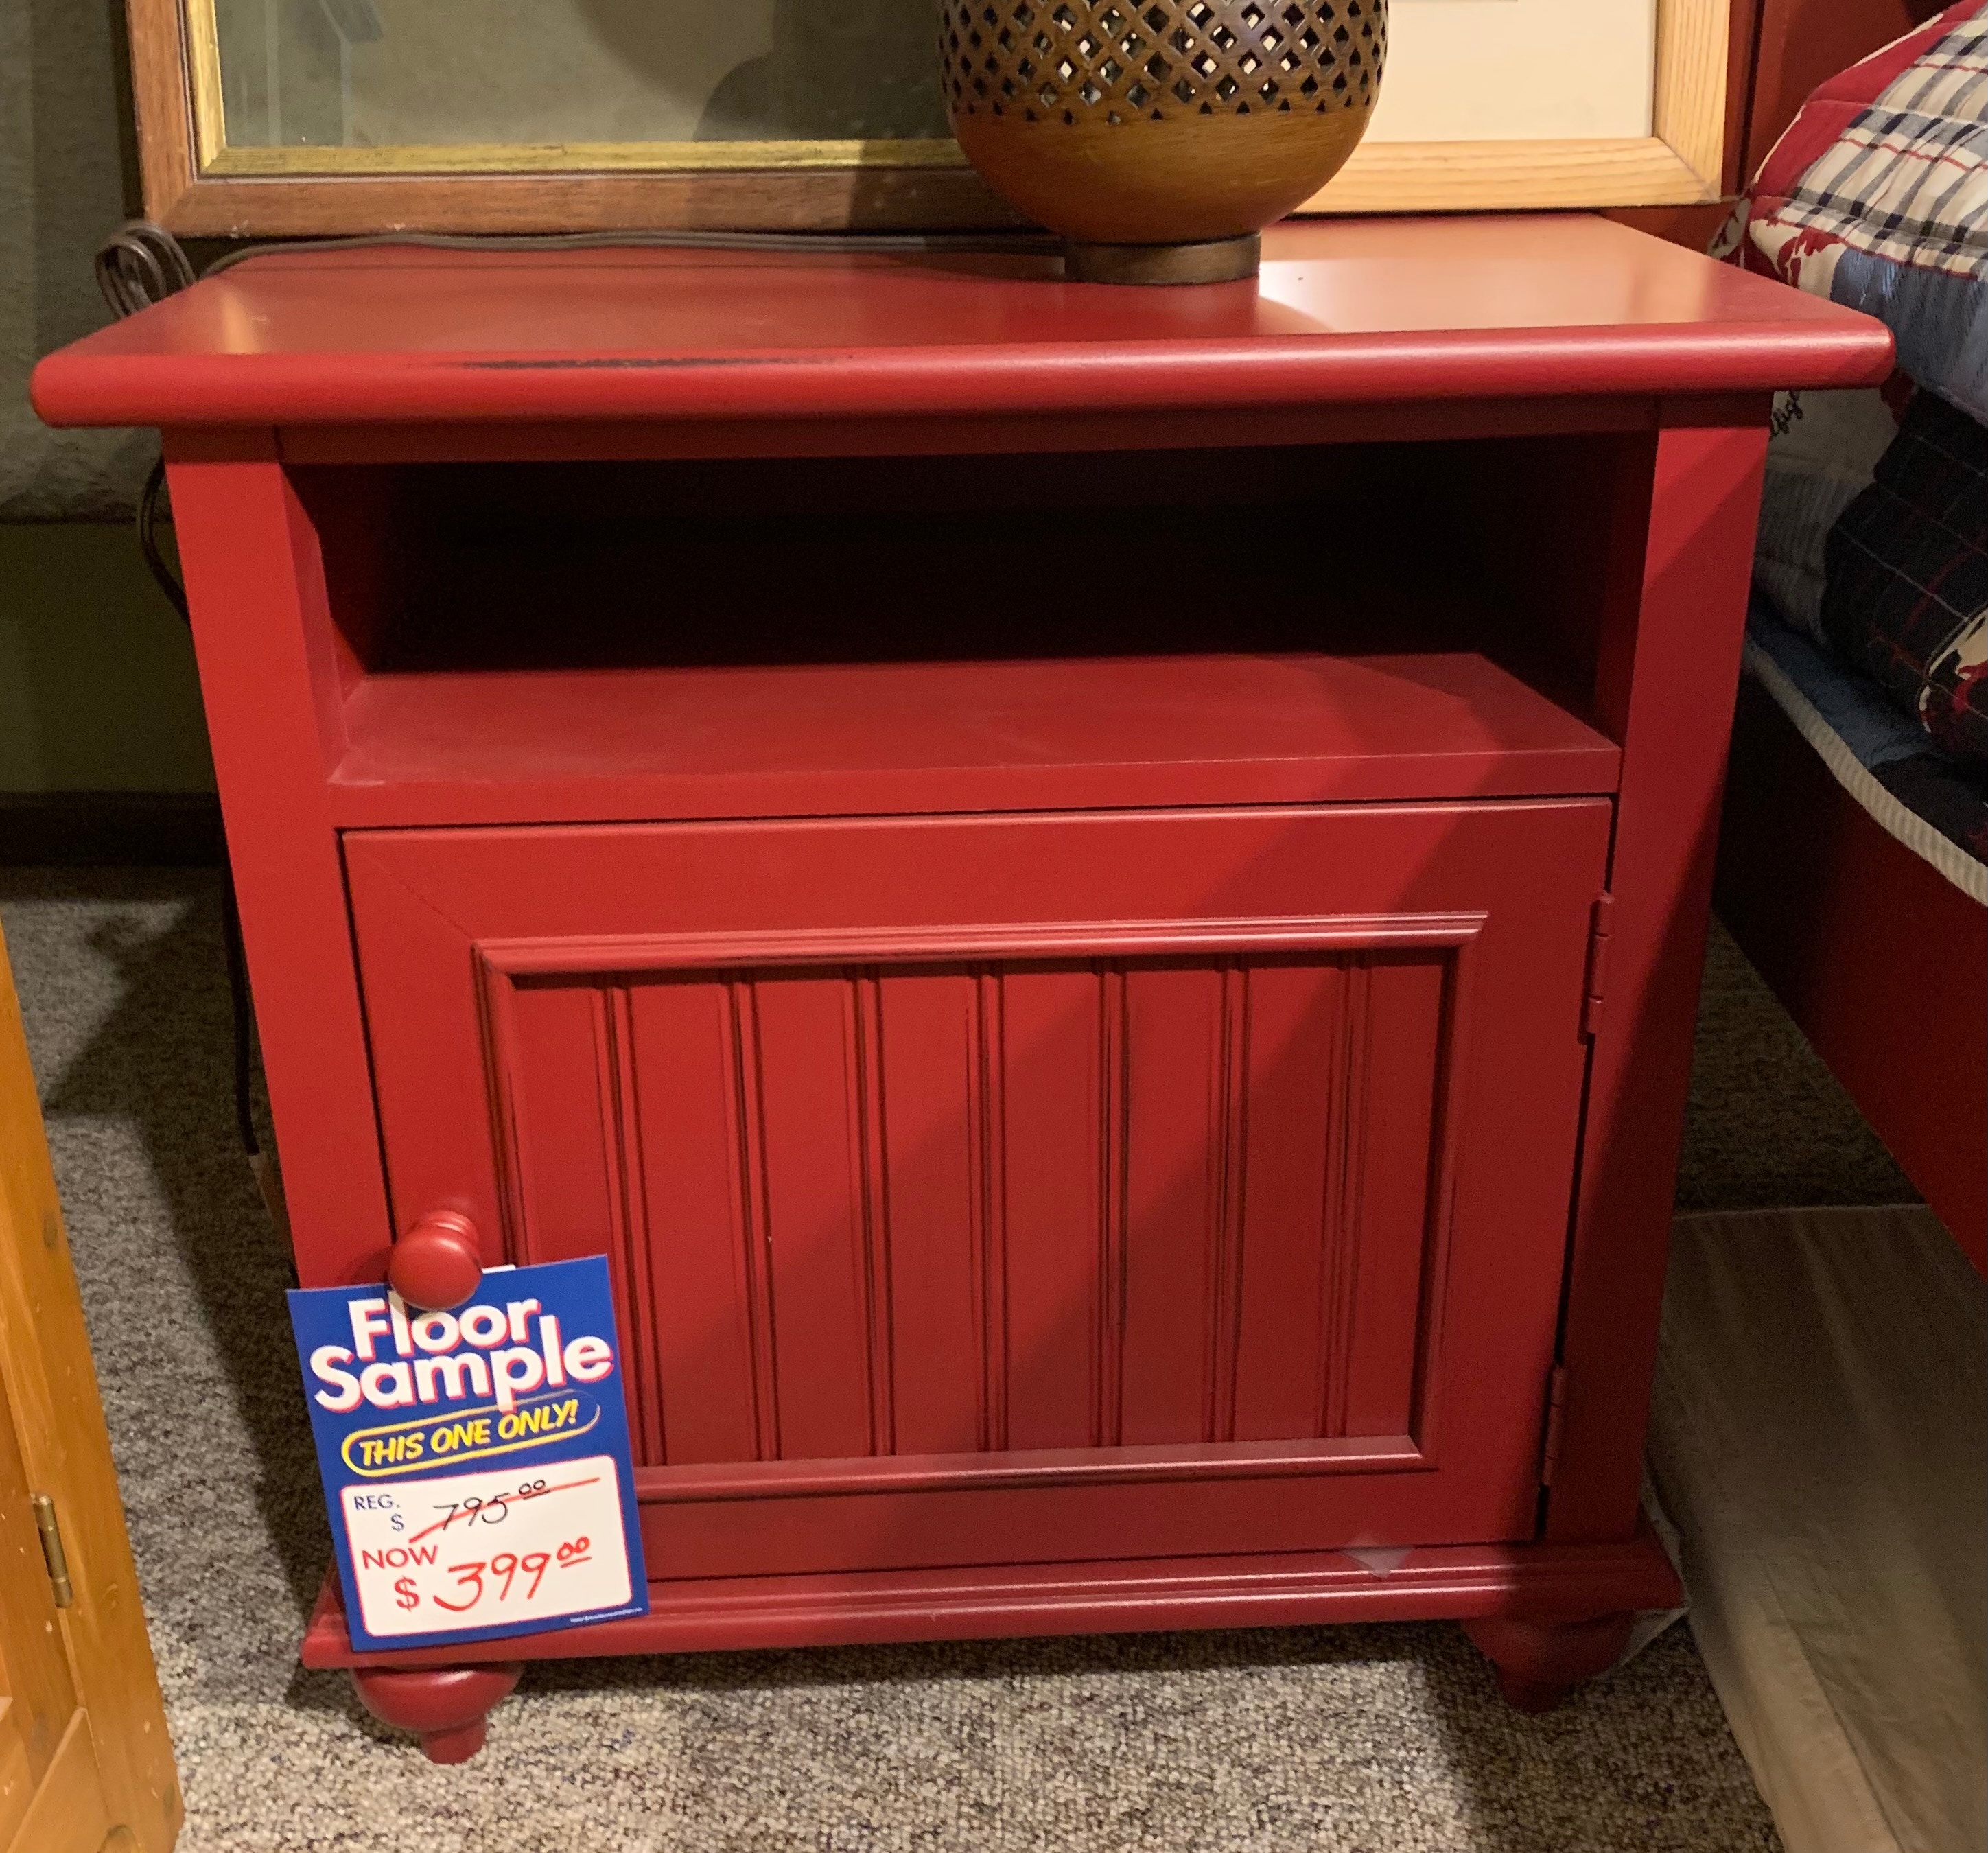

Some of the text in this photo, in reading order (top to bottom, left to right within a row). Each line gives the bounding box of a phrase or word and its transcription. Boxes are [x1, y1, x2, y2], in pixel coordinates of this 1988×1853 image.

[347, 1290, 541, 1362] Floor
[309, 1315, 614, 1414] Sample
[359, 1398, 579, 1467] THIS ONE ONLY!
[353, 1493, 401, 1511] REG.
[361, 1544, 438, 1570] NOW
